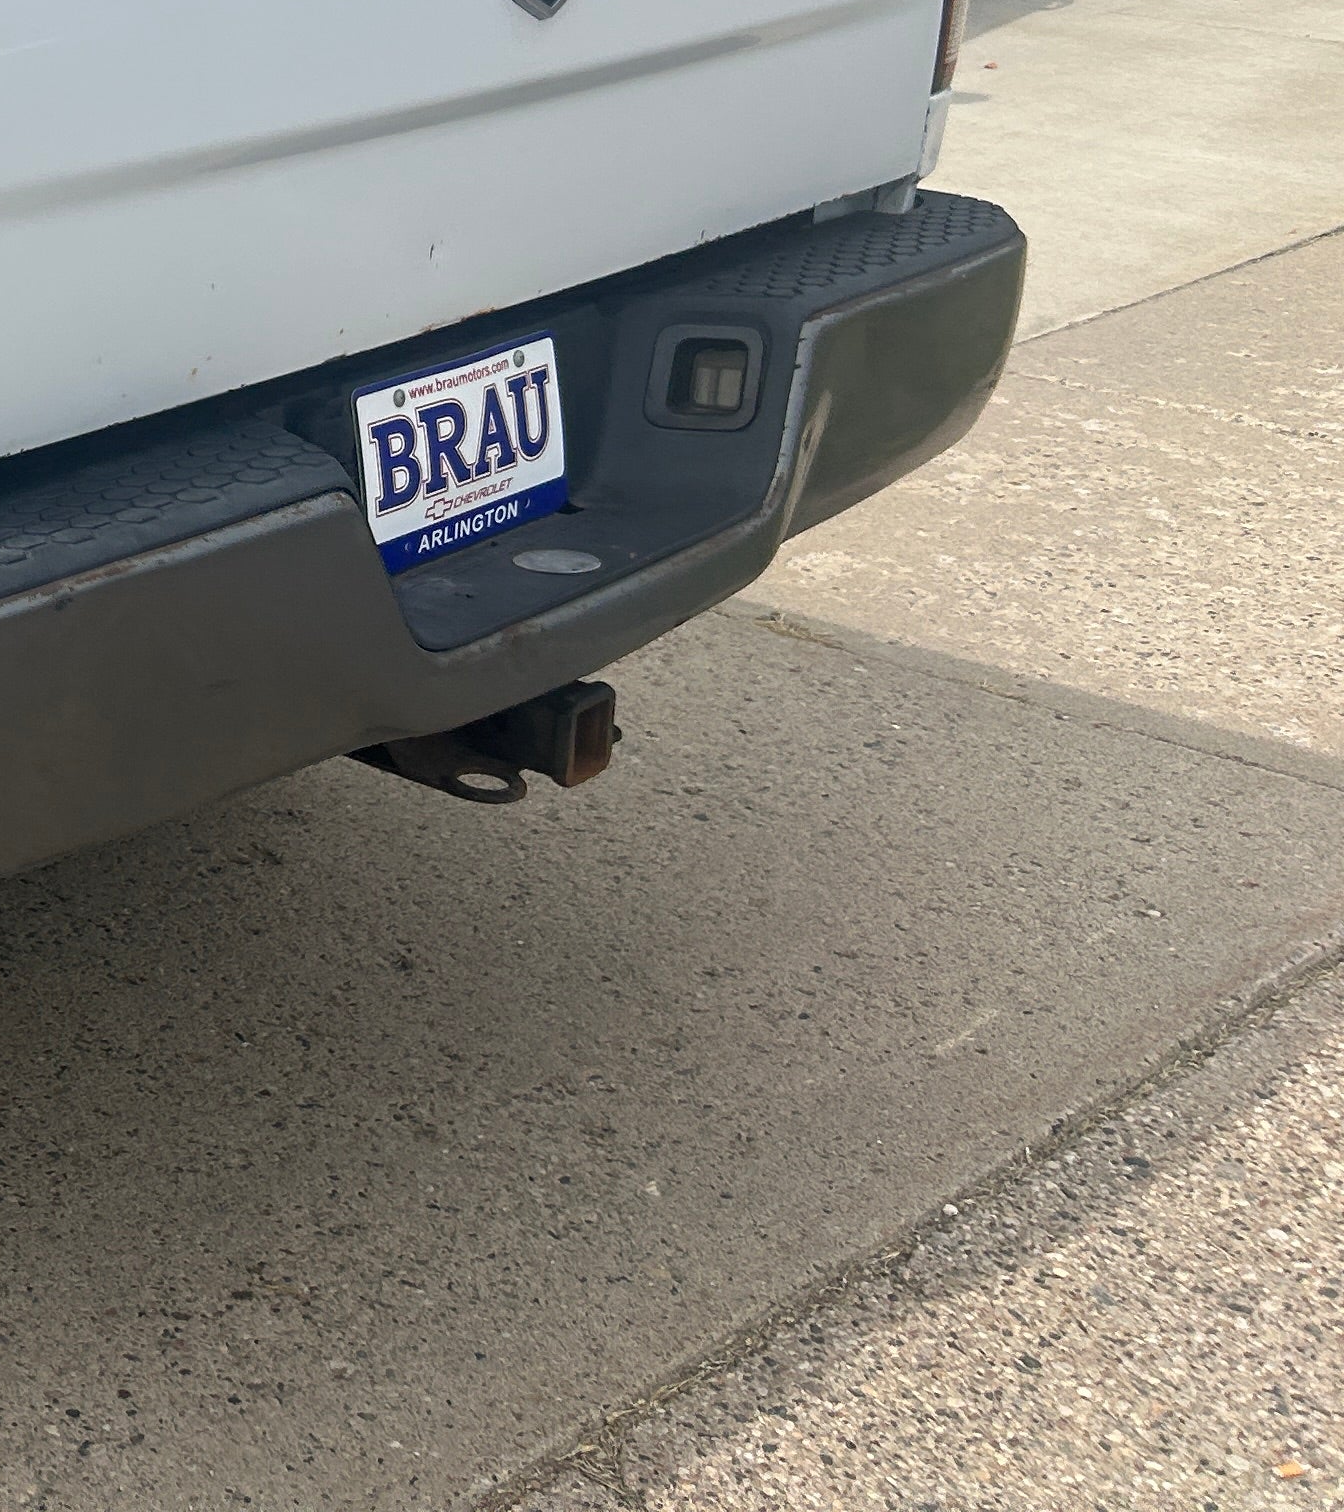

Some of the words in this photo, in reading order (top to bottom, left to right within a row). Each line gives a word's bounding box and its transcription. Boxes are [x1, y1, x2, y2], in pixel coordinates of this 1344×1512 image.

[408, 360, 509, 399] www.braumotors.com
[367, 364, 550, 516] BRAU
[453, 477, 514, 509] CHEVROLET
[418, 500, 518, 554] ARLINGTON
